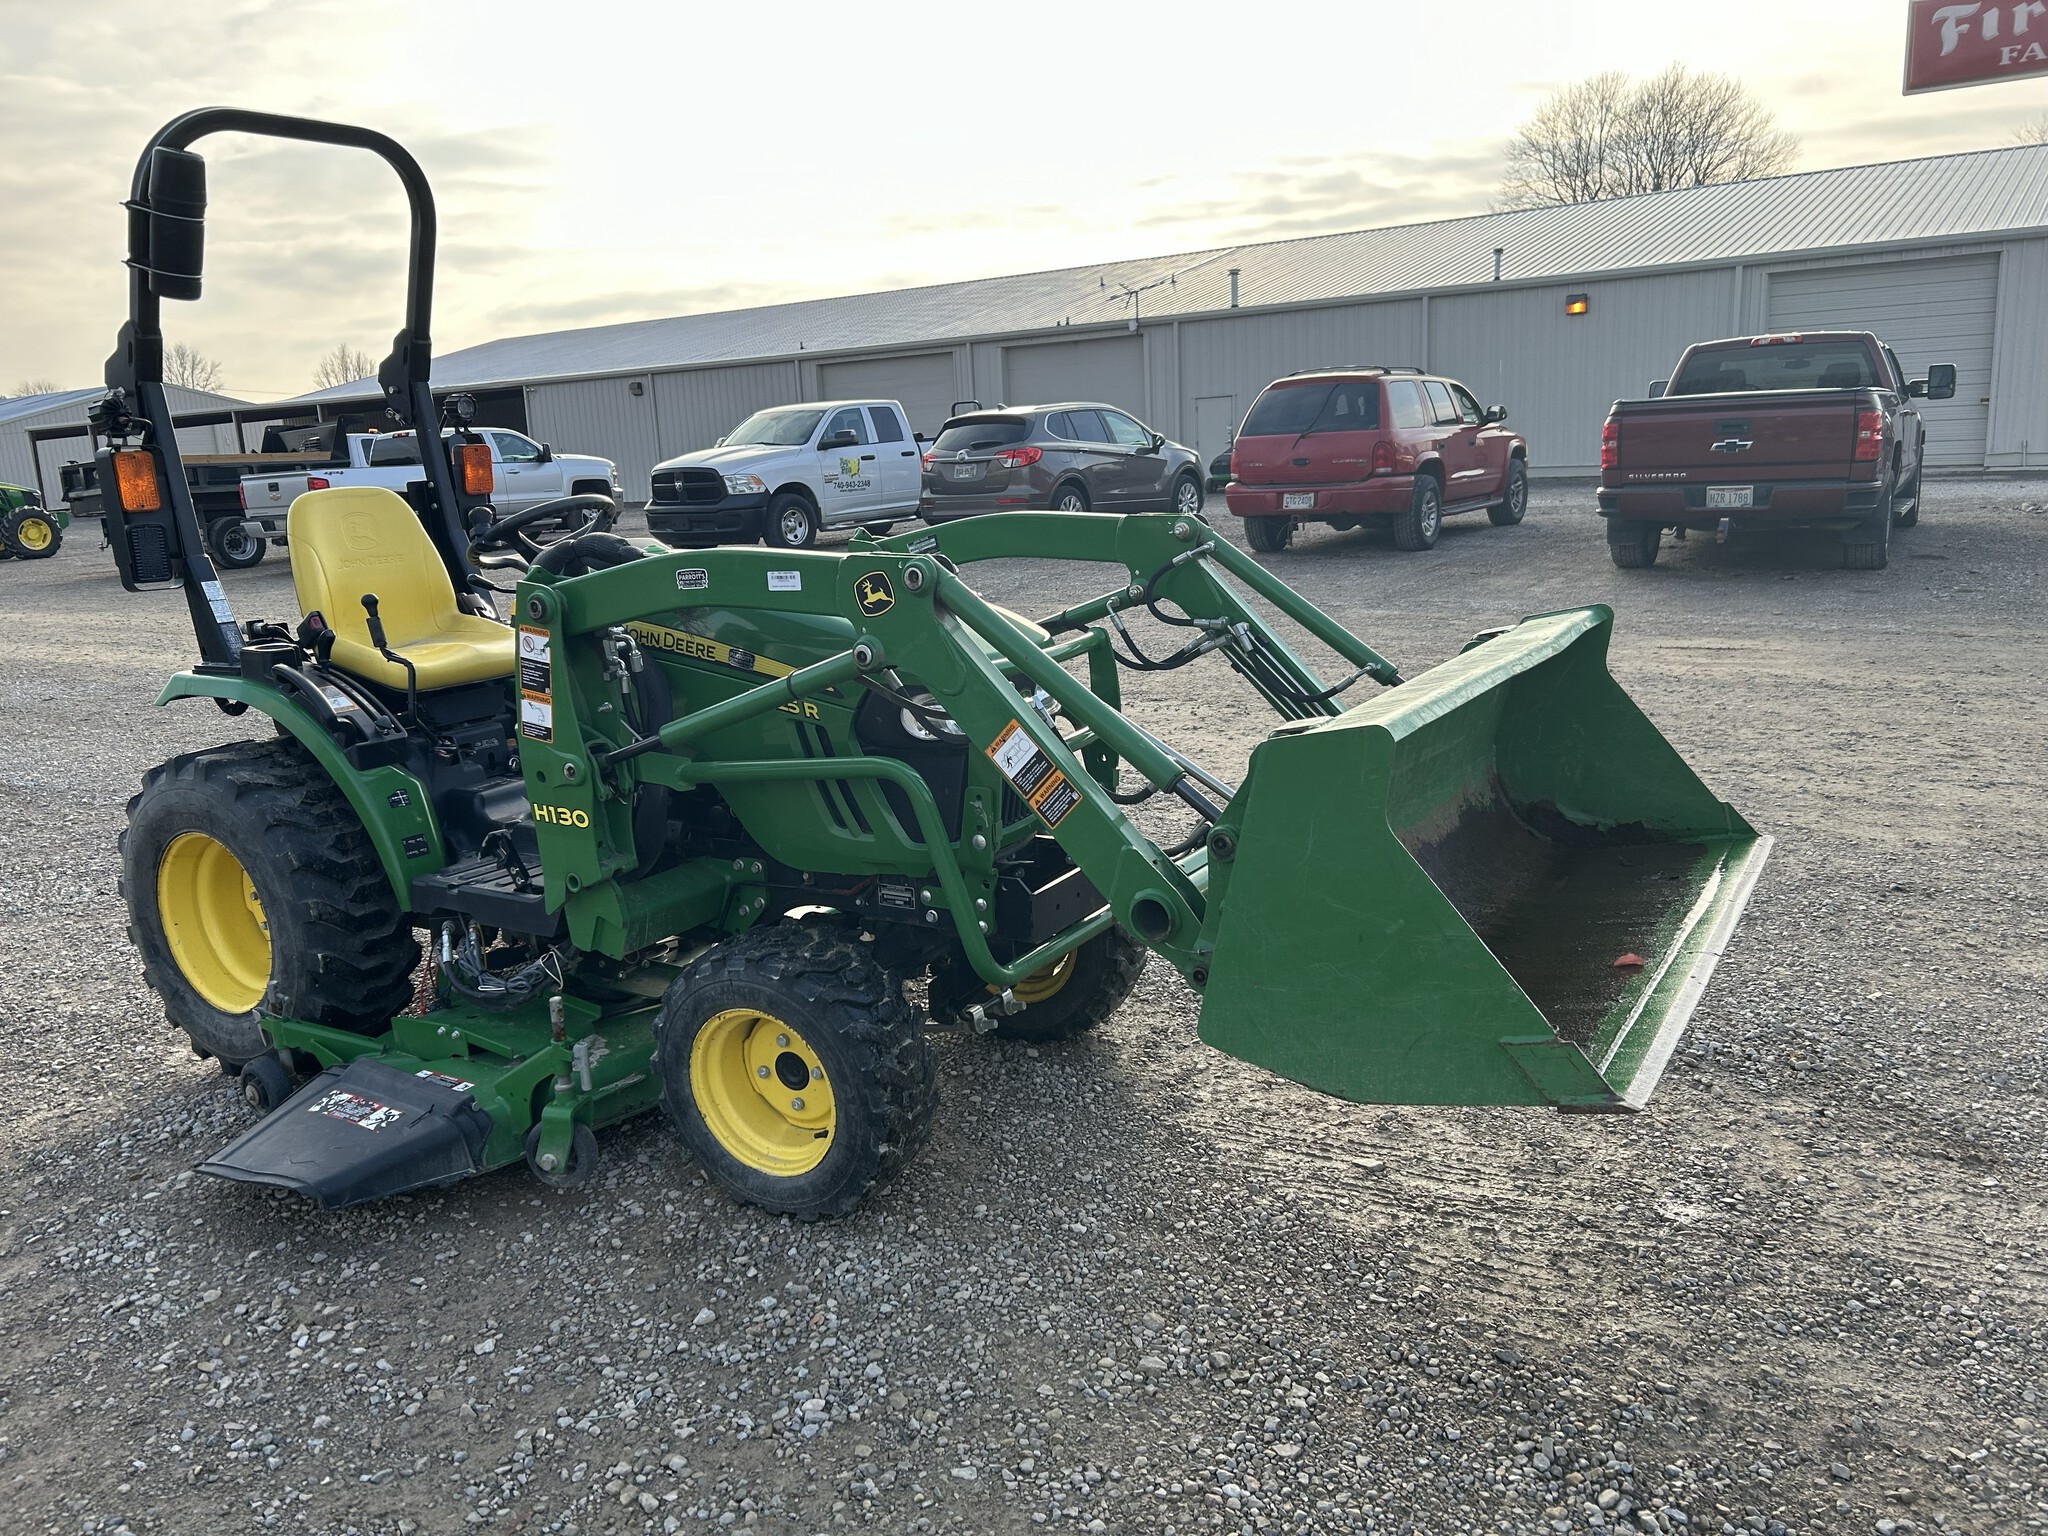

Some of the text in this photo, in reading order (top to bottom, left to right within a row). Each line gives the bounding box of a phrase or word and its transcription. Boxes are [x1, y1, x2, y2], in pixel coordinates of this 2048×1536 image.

[1710, 492, 1749, 504] HZR 1788
[367, 553, 404, 566] DEERE
[663, 631, 717, 660] DEERE
[995, 723, 1016, 748] WARNING
[1039, 775, 1061, 800] WARNING
[533, 803, 590, 828] H130
